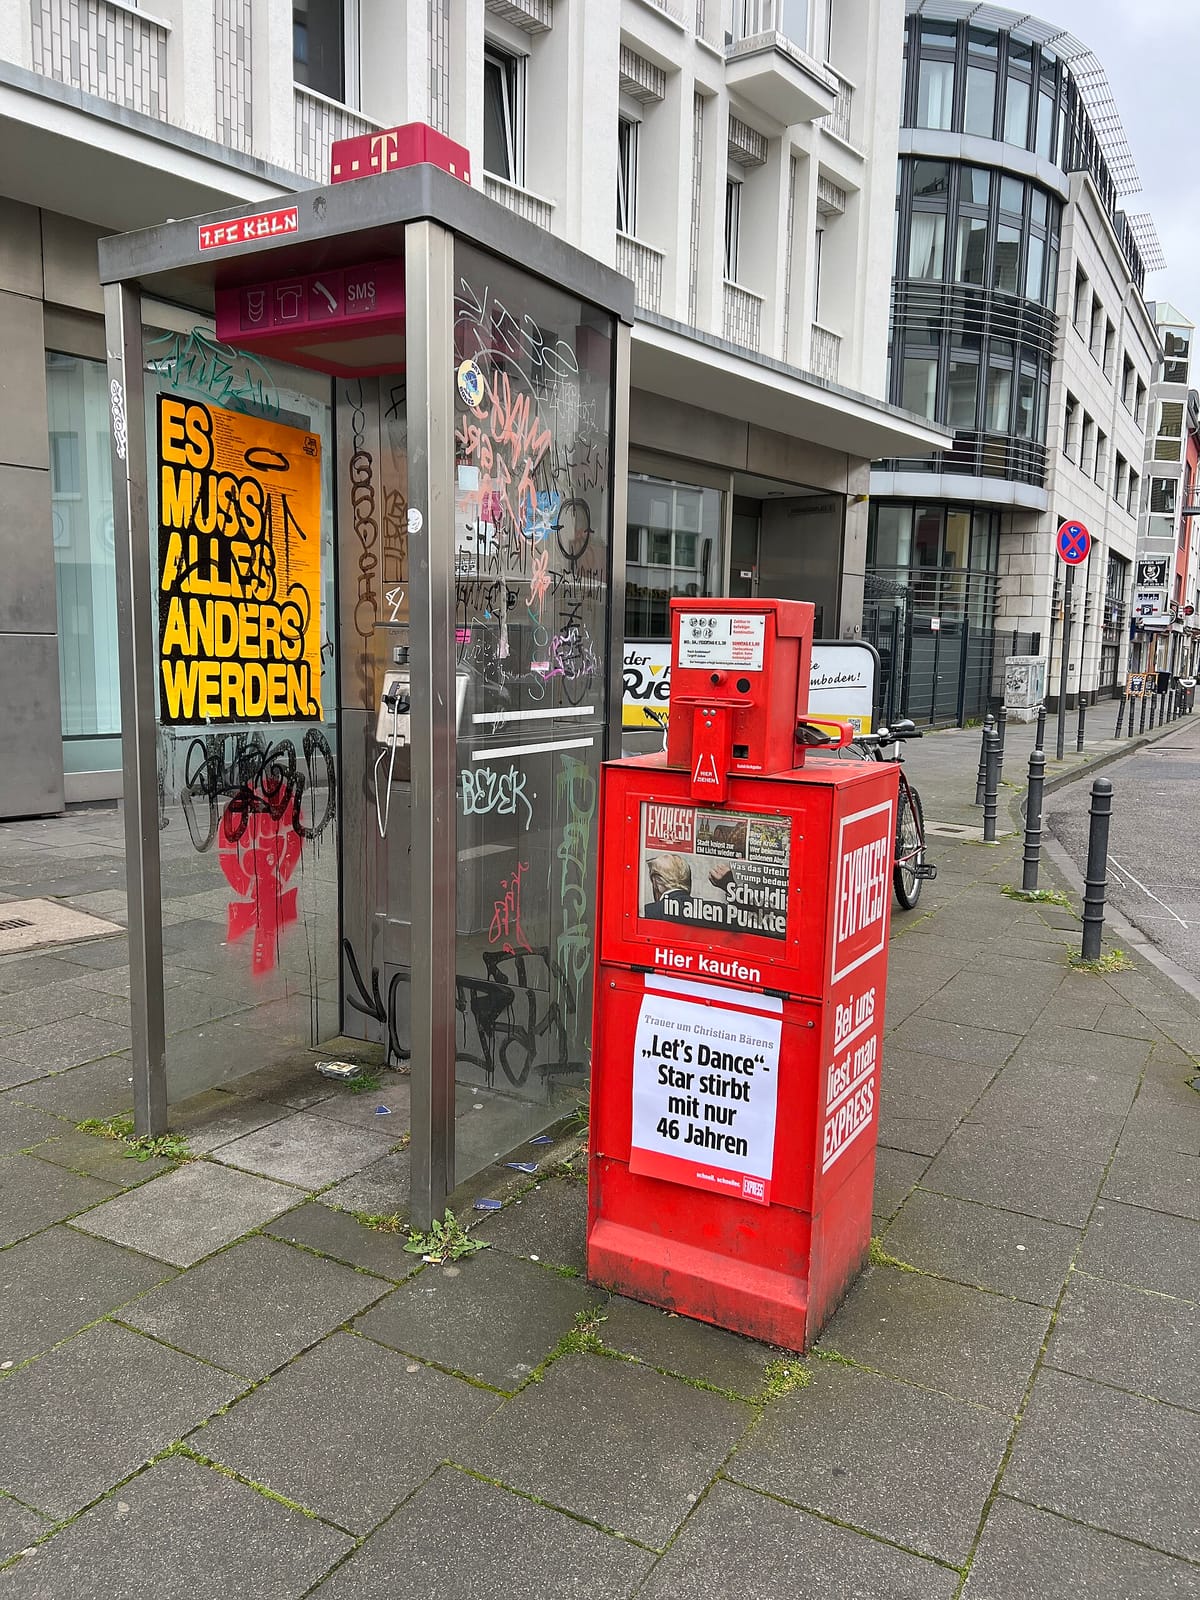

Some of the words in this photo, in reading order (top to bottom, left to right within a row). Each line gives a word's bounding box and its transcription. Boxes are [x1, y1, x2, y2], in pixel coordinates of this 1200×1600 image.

[243, 213, 297, 239] KÖLN
[347, 281, 376, 301] SMS
[161, 399, 210, 469] ES
[161, 465, 262, 541] MUSS
[161, 532, 272, 602] ALLES
[162, 597, 302, 661] ANDERS
[624, 651, 651, 666] der
[161, 660, 317, 718] WERDEN.
[648, 805, 693, 842] EXPRESS
[730, 861, 746, 872] Was
[748, 864, 762, 873] das
[763, 864, 785, 877] Urteil
[736, 872, 761, 884] Trump
[726, 882, 789, 913] Schuldi
[838, 836, 887, 943] EXPRESS
[663, 895, 680, 916] in
[682, 898, 723, 923] allen
[726, 904, 786, 933] Punkte
[654, 948, 693, 969] Hier
[698, 954, 761, 982] kaufen
[644, 1014, 675, 1030] Trauer
[676, 1021, 692, 1034] um
[693, 1024, 737, 1042] Christian
[739, 1034, 774, 1050] Bärens
[834, 995, 854, 1045] Bei
[855, 987, 876, 1027] uns
[657, 1064, 695, 1091] Star
[699, 1074, 751, 1103] stirbt
[826, 1052, 852, 1105] liest
[853, 1034, 877, 1077] man
[668, 1095, 700, 1119] mit
[704, 1106, 737, 1126] nur
[823, 1076, 875, 1160] EXPRESS
[656, 1117, 680, 1140] 46
[684, 1123, 749, 1157] Jahren
[744, 1179, 764, 1197] EXPRESS
